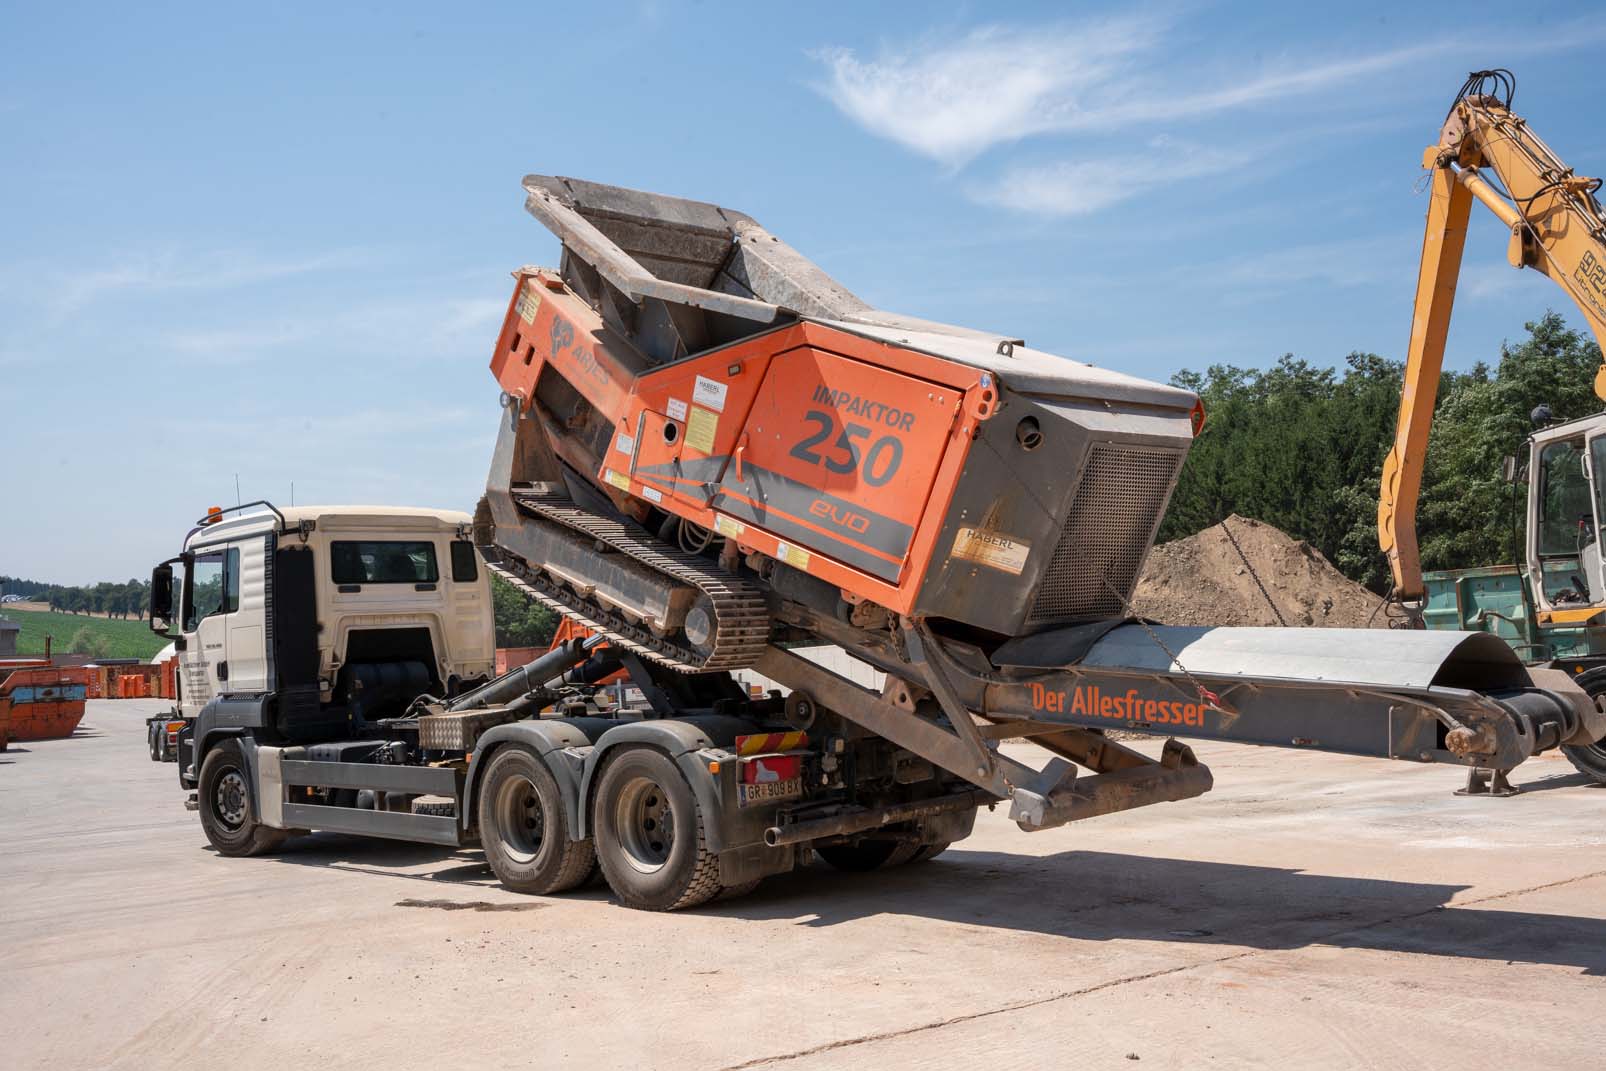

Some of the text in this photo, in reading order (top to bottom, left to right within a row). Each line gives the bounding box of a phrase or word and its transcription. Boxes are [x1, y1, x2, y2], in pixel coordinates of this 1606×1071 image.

[1580, 250, 1606, 298] 92
[812, 384, 916, 432] IMPAKTOR
[789, 410, 904, 488] 250
[967, 530, 1014, 550] HABERL
[748, 779, 800, 799] GR 909 BX
